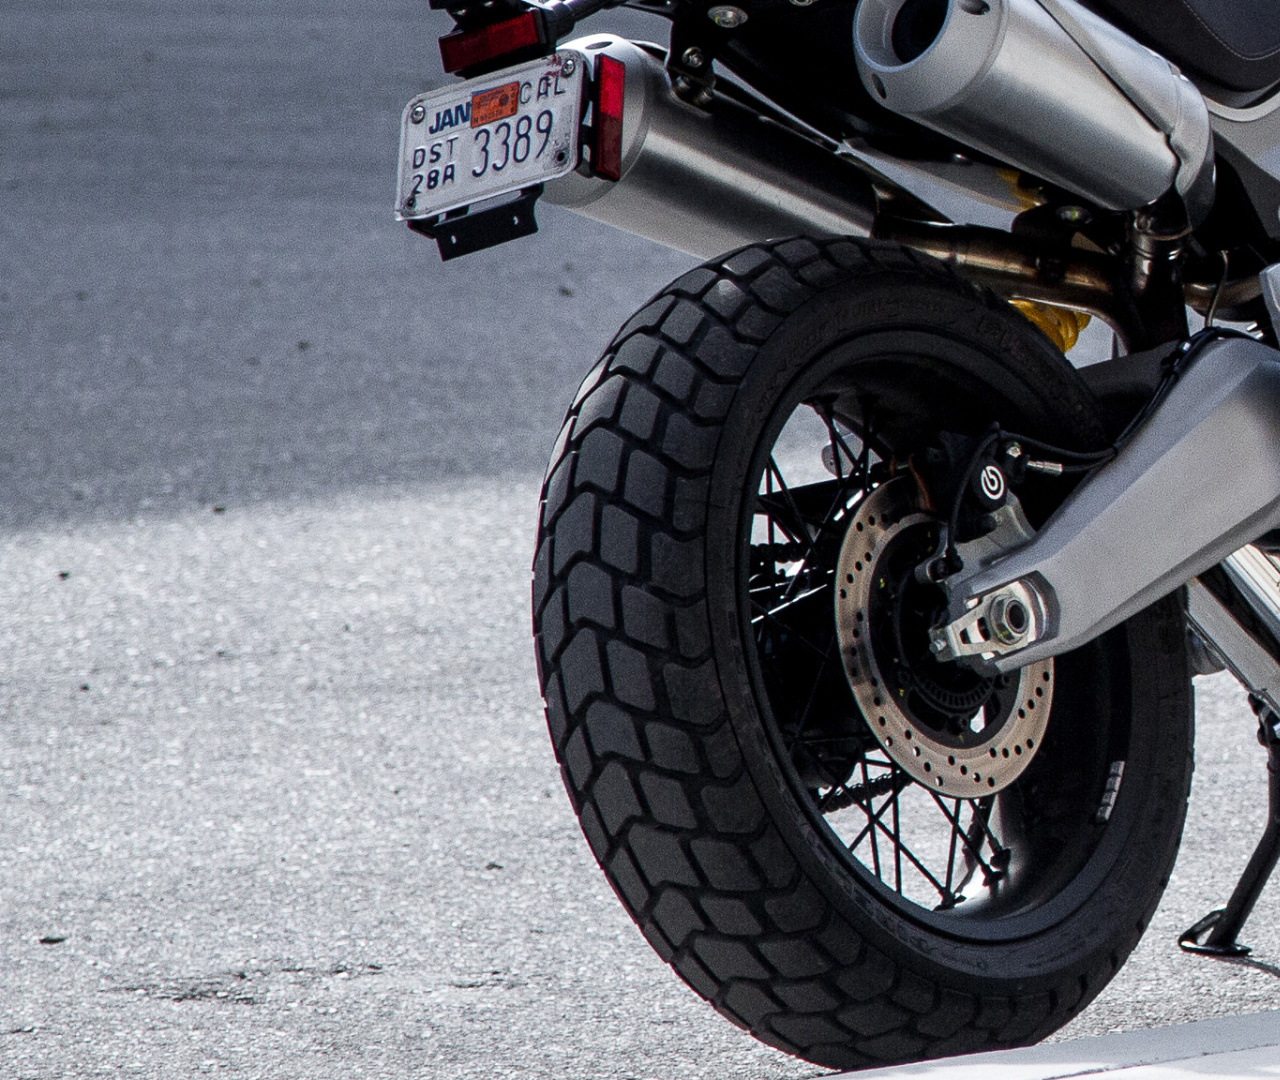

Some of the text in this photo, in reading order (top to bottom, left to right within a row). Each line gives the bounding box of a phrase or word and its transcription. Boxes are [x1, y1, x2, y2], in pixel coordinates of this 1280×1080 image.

[429, 101, 472, 134] JAN
[412, 136, 459, 169] DST
[472, 109, 553, 178] 3389
[411, 164, 456, 195] 28A
